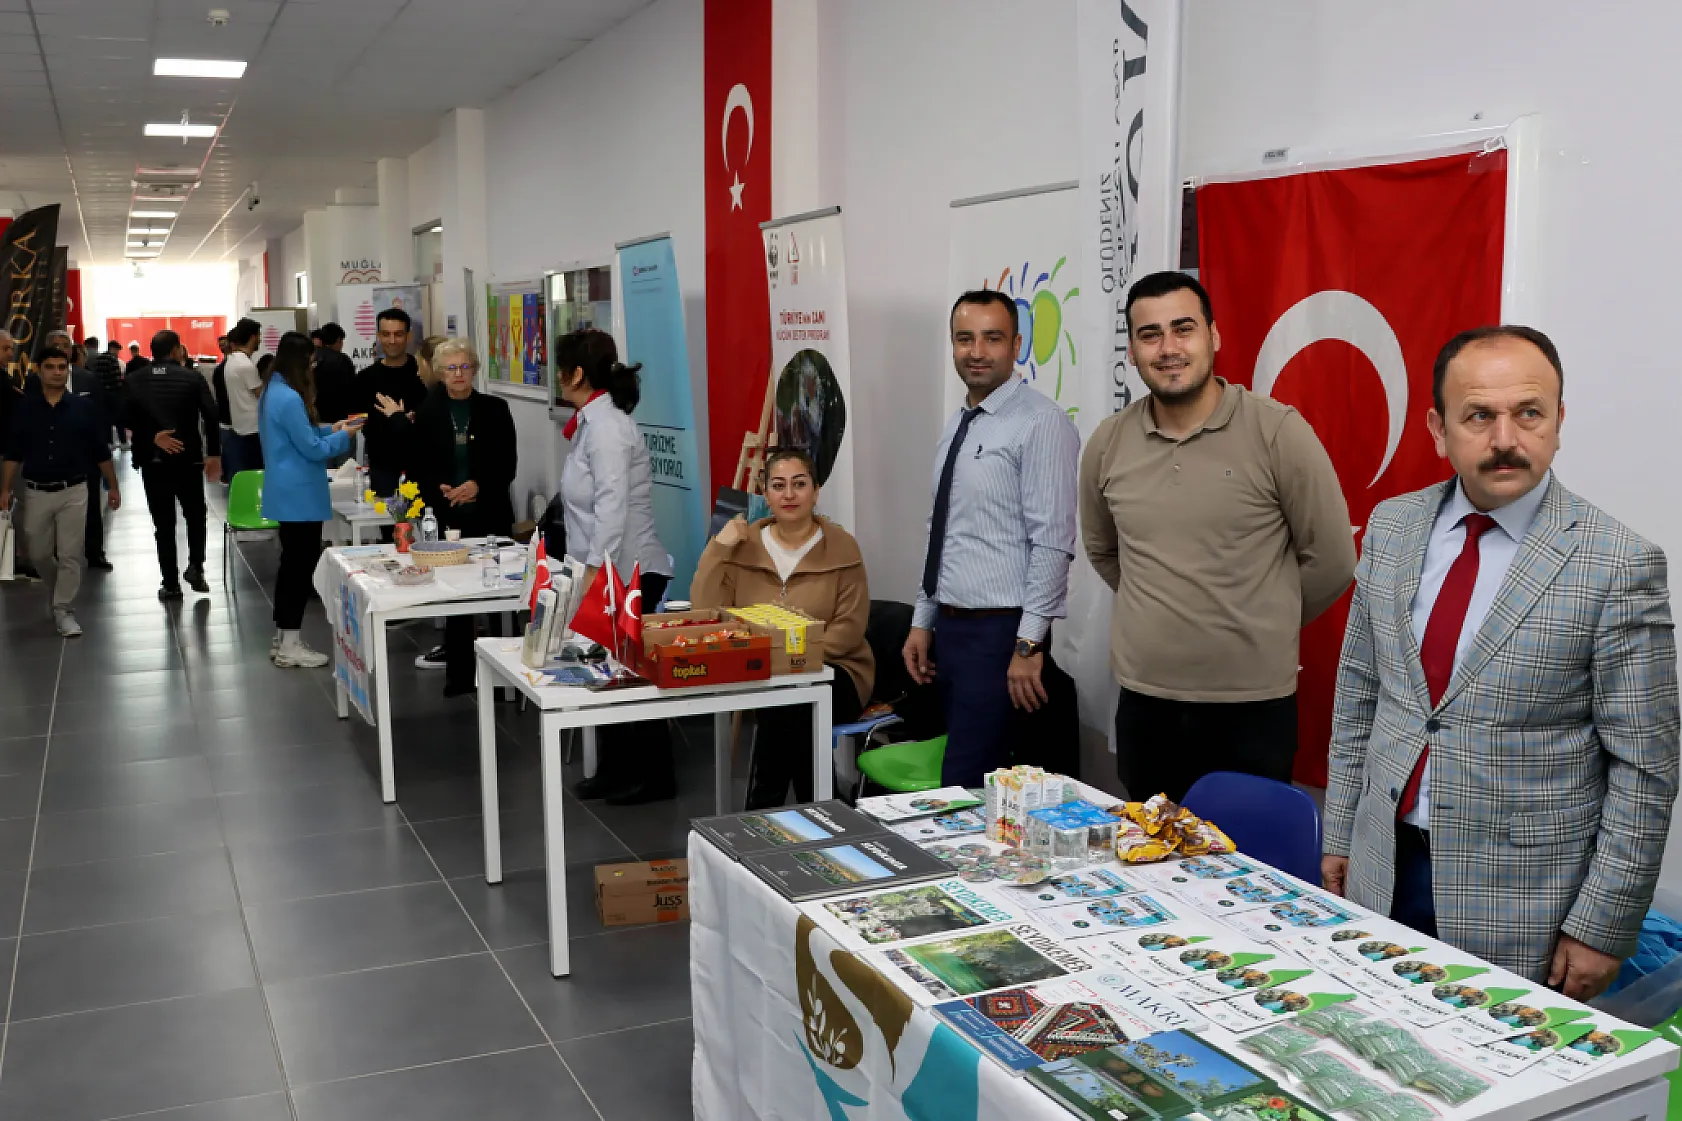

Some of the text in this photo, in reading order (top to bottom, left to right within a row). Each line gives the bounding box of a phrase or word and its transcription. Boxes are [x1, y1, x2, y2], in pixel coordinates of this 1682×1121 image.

[10, 229, 37, 345] ORKA
[652, 893, 683, 908] Juss
[1009, 924, 1093, 973] SEYDİKEMER
